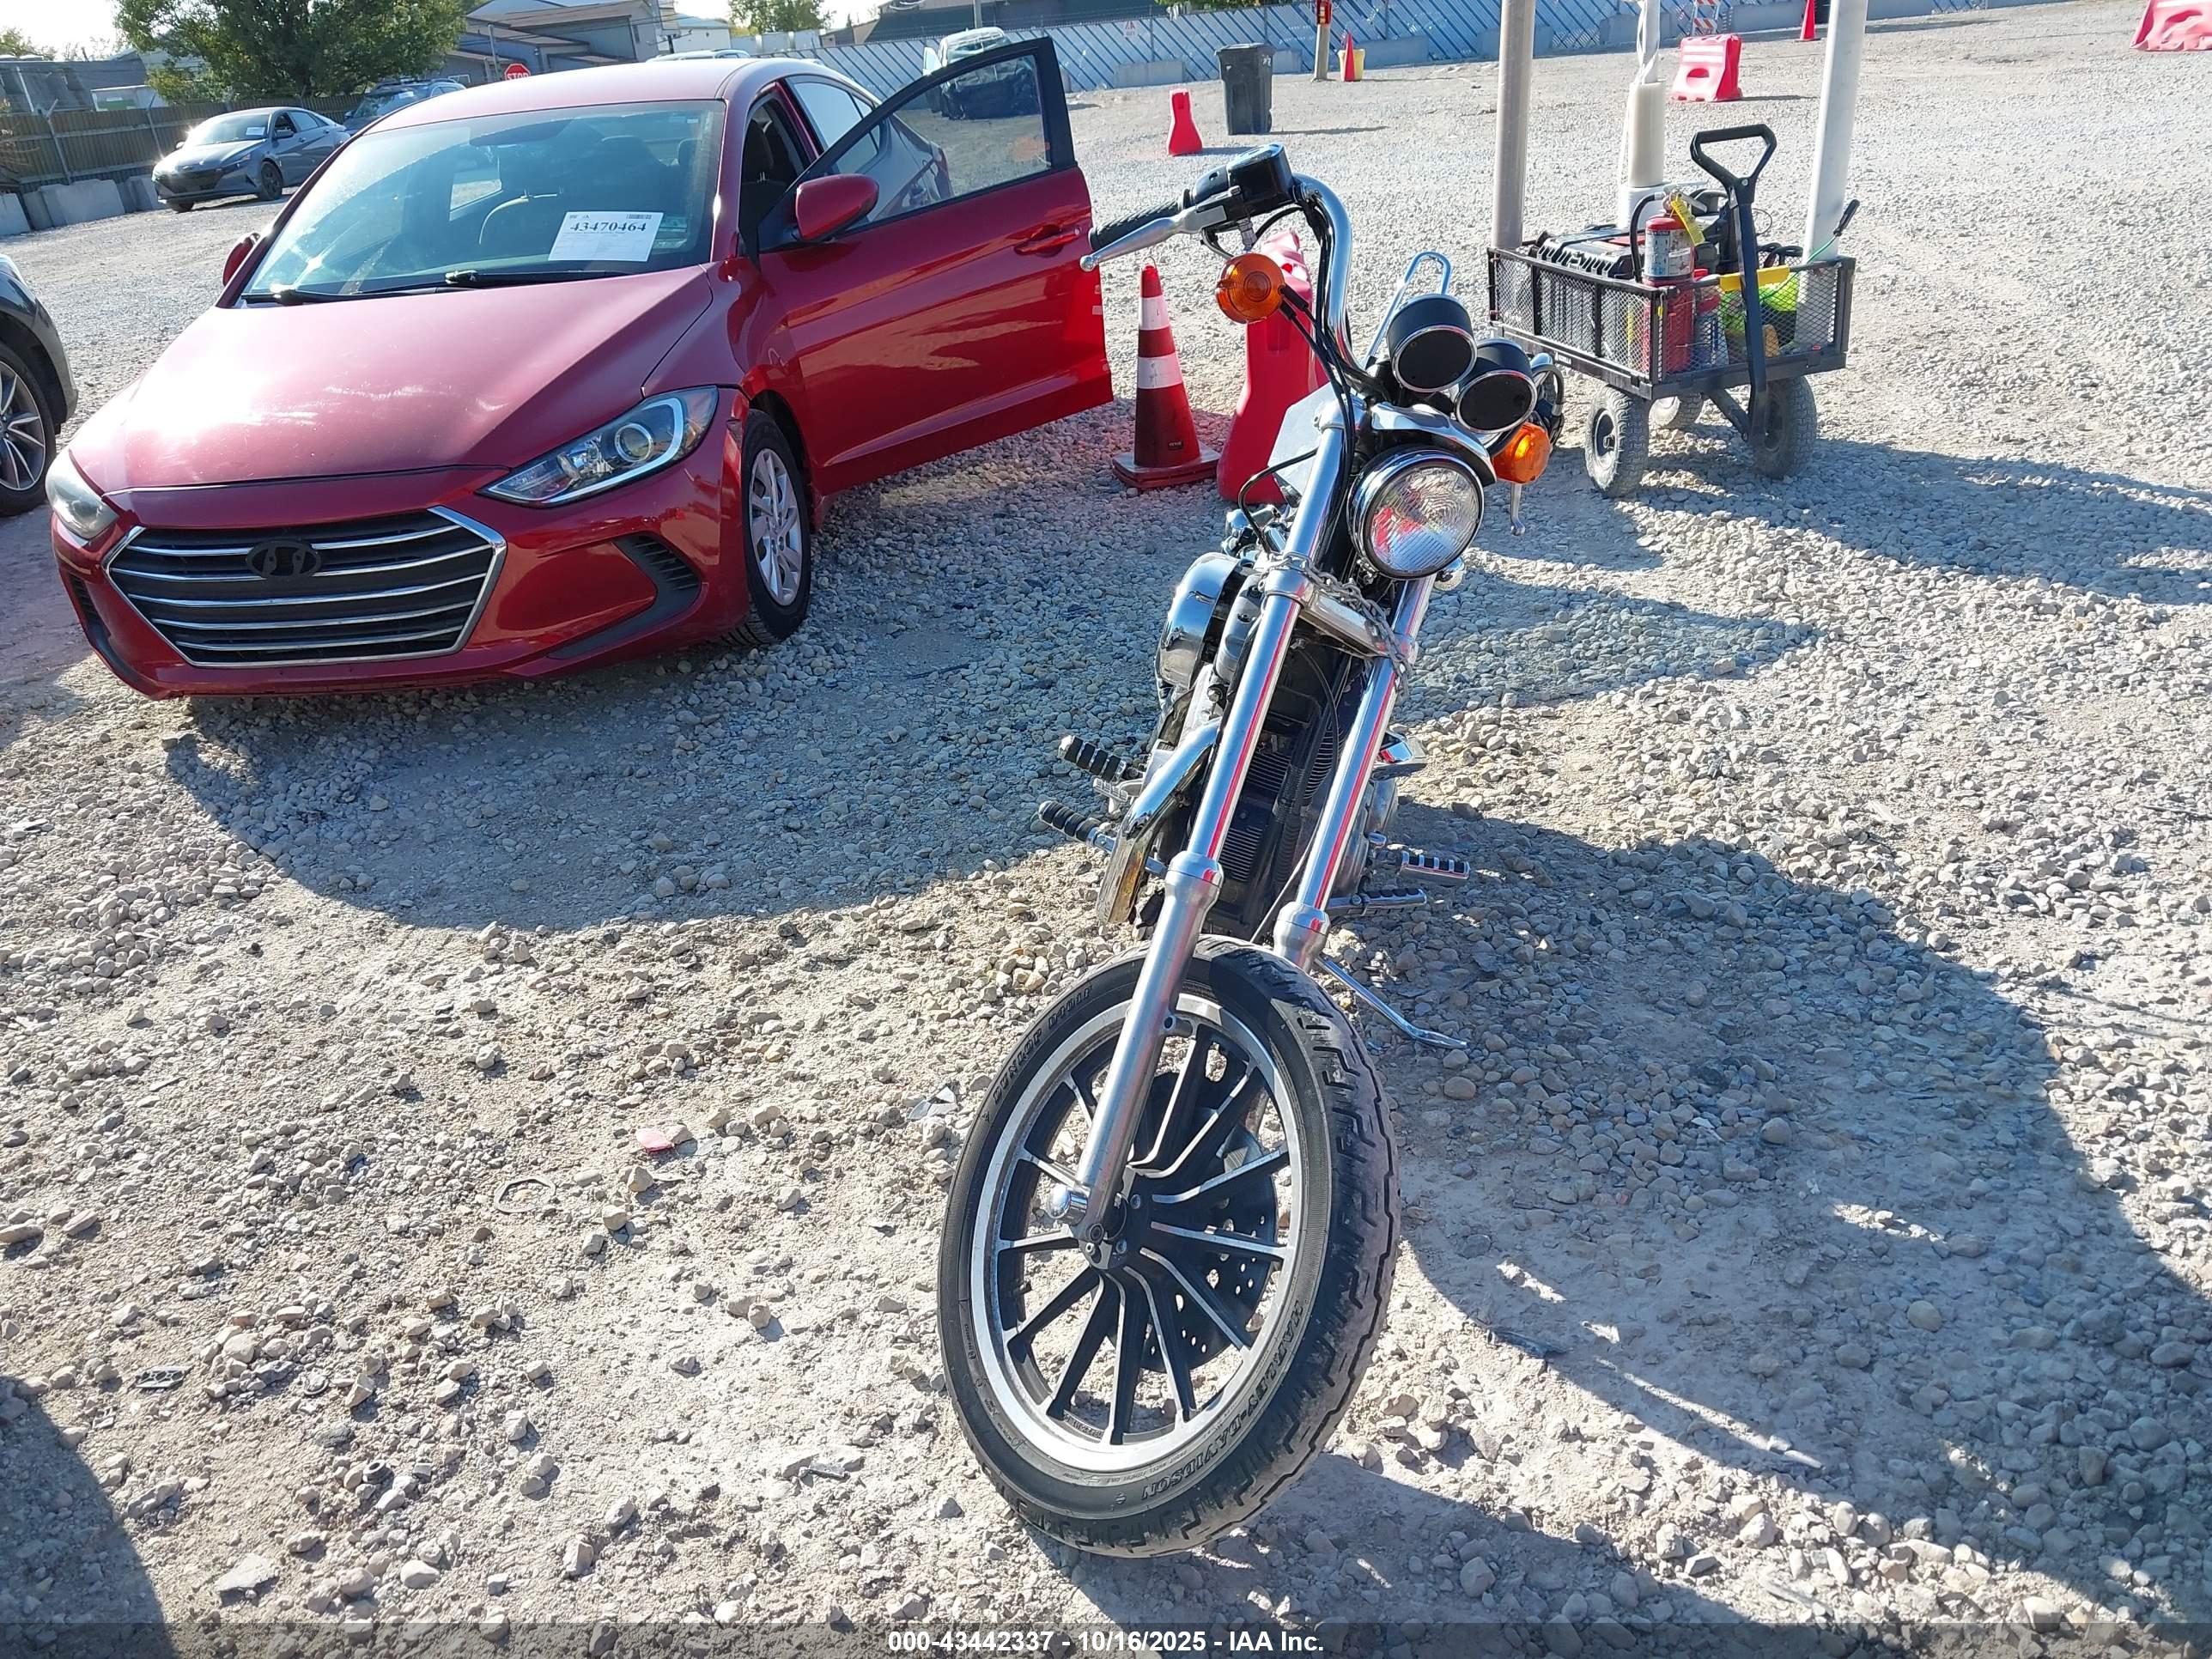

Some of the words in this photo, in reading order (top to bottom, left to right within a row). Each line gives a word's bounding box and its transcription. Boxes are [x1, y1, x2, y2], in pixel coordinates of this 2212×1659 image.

[570, 222, 647, 232] 43470464
[993, 1026, 1042, 1105] DUNLOP
[1140, 1299, 1304, 1499] HARLEY-DAVIDSON
